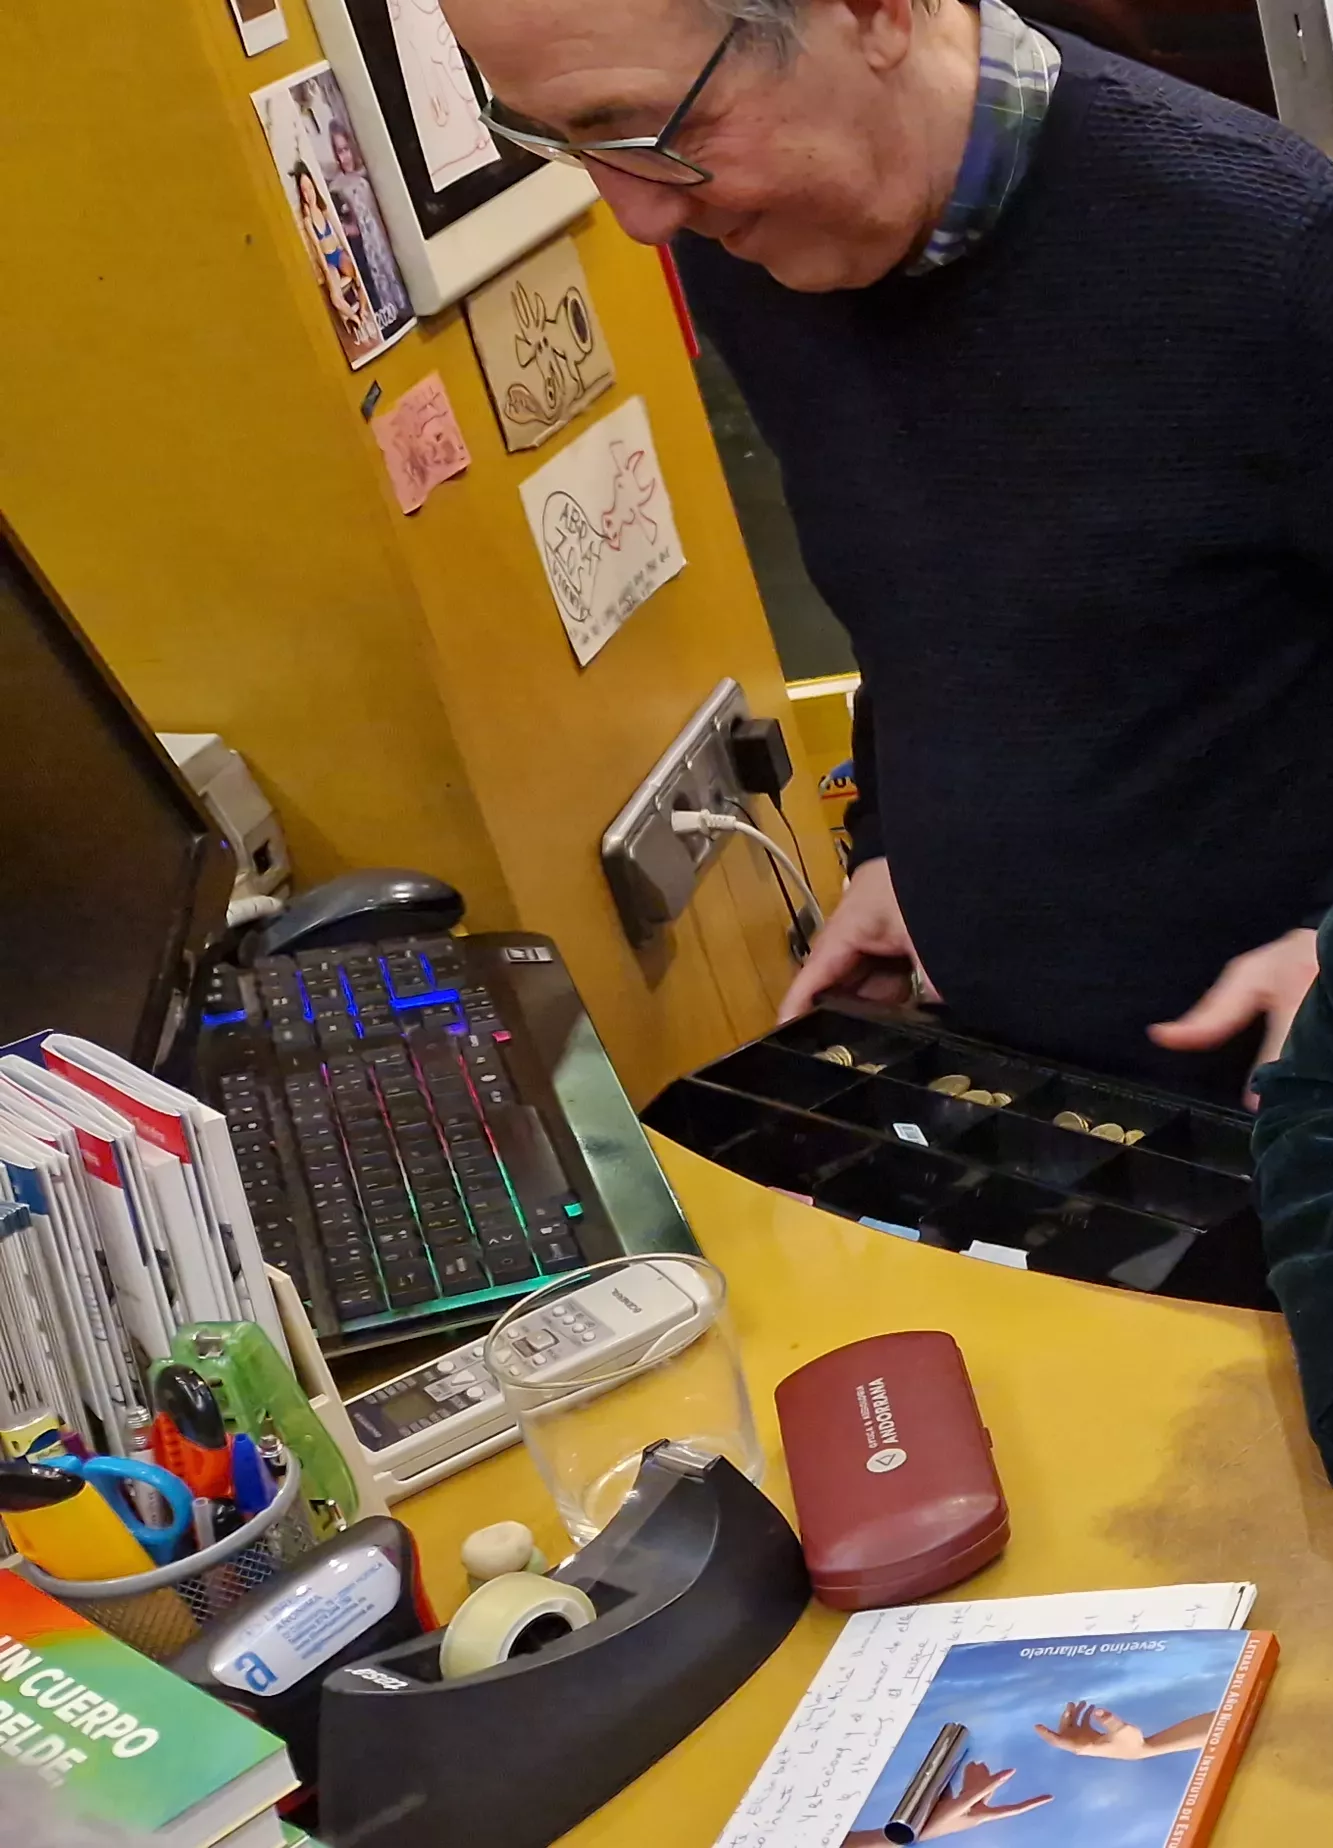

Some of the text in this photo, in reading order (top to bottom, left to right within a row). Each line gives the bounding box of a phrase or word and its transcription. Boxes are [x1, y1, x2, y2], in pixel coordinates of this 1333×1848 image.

[868, 1377, 899, 1444] ANDORRANA
[1020, 1639, 1168, 1660] Severino Pallaruelo
[1240, 1638, 1261, 1674] LETRAS
[234, 1651, 279, 1692] a
[351, 1667, 409, 1690] tesa
[1232, 1672, 1247, 1690] DEL
[19, 1668, 160, 1758] CUERPO
[1222, 1691, 1240, 1713] AÑO
[1209, 1713, 1233, 1746] NUEVO
[1185, 1755, 1216, 1809] INSTITUTO
[1180, 1808, 1194, 1823] DE
